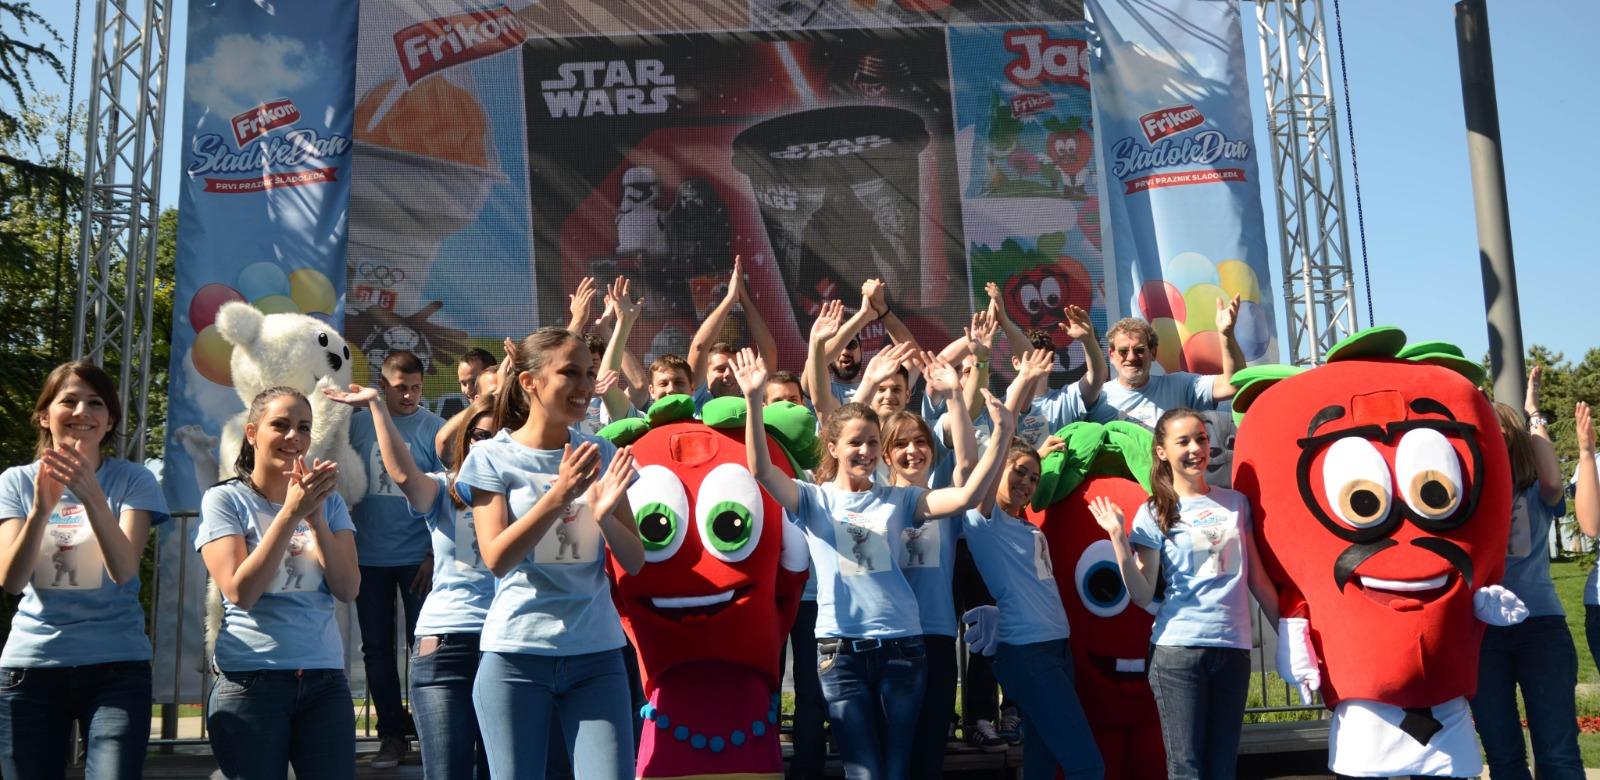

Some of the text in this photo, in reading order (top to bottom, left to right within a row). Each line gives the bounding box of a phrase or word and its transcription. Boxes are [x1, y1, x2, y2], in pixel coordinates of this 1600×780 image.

[402, 13, 522, 70] Frikom
[541, 59, 676, 90] STAR
[542, 86, 677, 118] WARS
[236, 102, 297, 139] Frikom
[1144, 108, 1201, 137] Frikom
[1112, 130, 1249, 177] SladoleDan
[215, 182, 238, 190] PRVI
[239, 179, 272, 189] PRAZNIK
[1135, 171, 1238, 189] PRVI PRAZNIK SLADOLEDA
